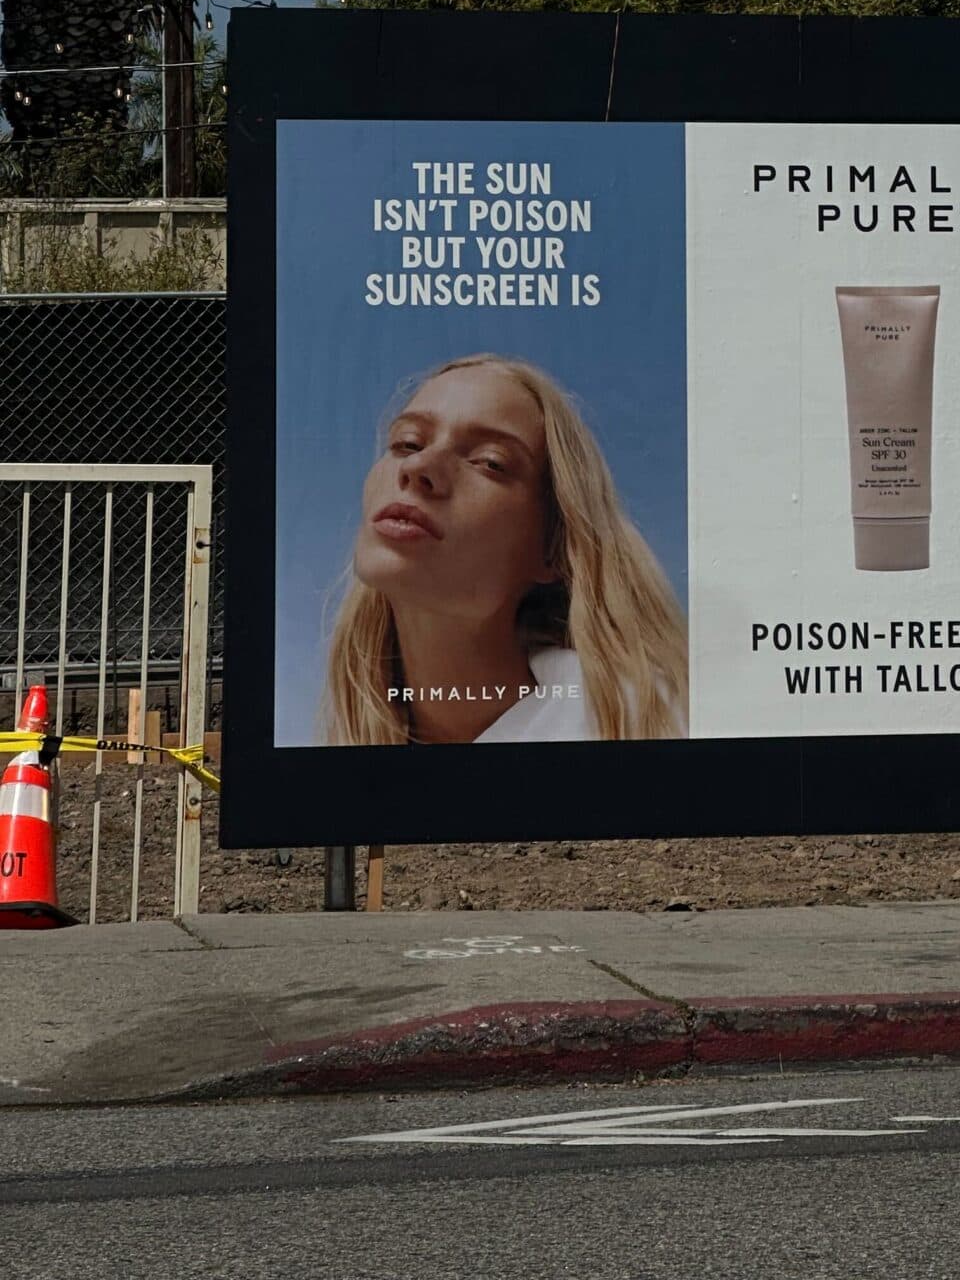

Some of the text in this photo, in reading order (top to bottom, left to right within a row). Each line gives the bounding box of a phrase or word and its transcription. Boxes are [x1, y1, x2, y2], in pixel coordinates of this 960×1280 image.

[413, 163, 550, 194] THE SUN
[375, 200, 590, 231] ISN'T POISON
[819, 205, 953, 232] PURE
[403, 237, 564, 269] BUT YOUR
[365, 274, 600, 305] SUNSCREEN IS
[862, 437, 915, 447] Sun Cream
[872, 450, 907, 460] SPF 30
[753, 621, 960, 651] POISON-FREE
[387, 686, 581, 702] PRIMALLY PURE
[785, 666, 862, 694] WITH
[0, 852, 28, 878] OT
